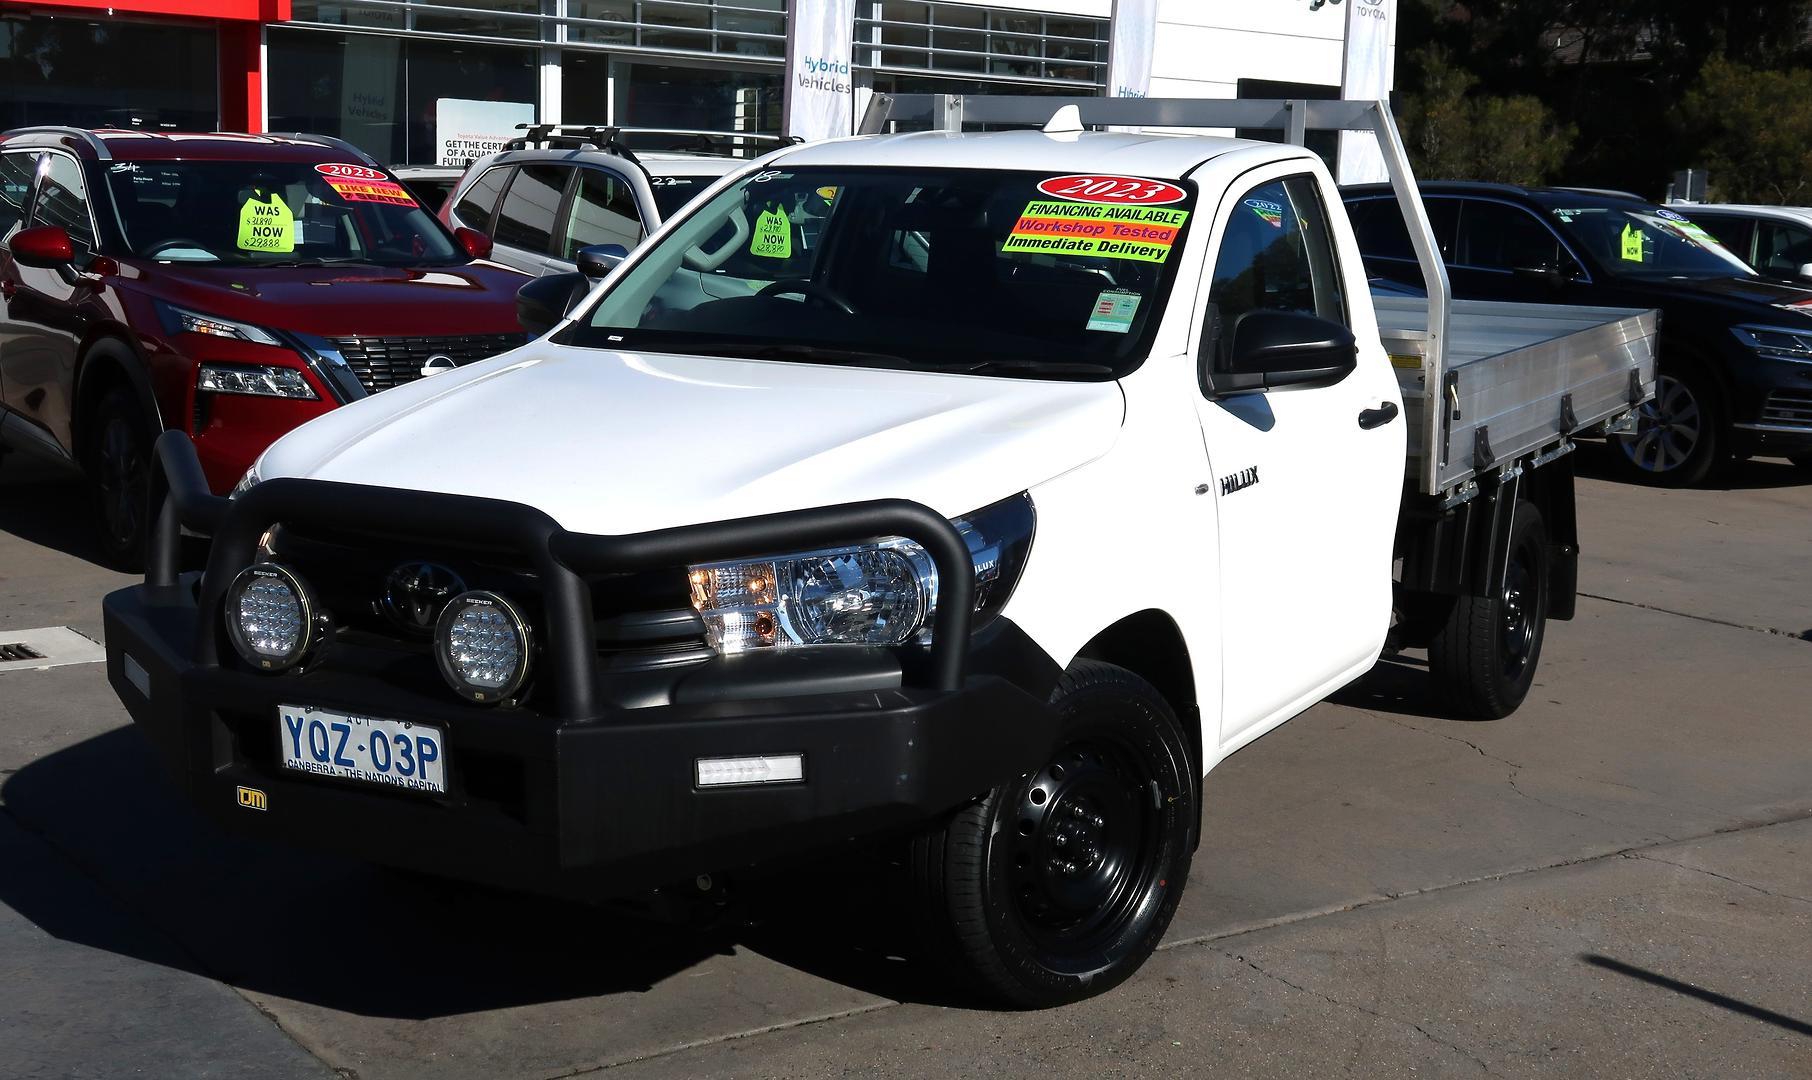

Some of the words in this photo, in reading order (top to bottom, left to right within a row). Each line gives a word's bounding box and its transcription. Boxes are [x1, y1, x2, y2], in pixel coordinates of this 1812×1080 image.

[1357, 6, 1386, 21] TOYOTA
[804, 55, 848, 75] Hybrid
[798, 73, 851, 94] Vehicles
[445, 140, 462, 148] GET
[463, 141, 480, 149] THE
[481, 142, 504, 151] CERT
[446, 149, 459, 157] OF
[459, 149, 467, 158] A
[329, 165, 375, 178] 2023
[651, 177, 677, 186] 22
[371, 186, 402, 197] NEW
[1056, 178, 1166, 200] 2023
[254, 205, 280, 217] WAS
[1027, 203, 1103, 218] FINANCING
[1104, 210, 1183, 225] AVAILABLE
[766, 216, 783, 226] WAS
[252, 226, 284, 238] NOW
[1018, 219, 1106, 236] Workshop
[1112, 224, 1173, 241] Tested
[763, 234, 785, 245] NOW
[1007, 235, 1094, 252] Immediate
[1096, 240, 1167, 260] Delivery
[1220, 464, 1260, 496] HILUX
[974, 559, 996, 574] ILUX
[253, 570, 278, 578] SEEKER
[466, 598, 493, 606] SEEKER
[287, 759, 336, 776] CANBERRA
[344, 768, 362, 780] THE
[407, 778, 445, 793] CAPITAL
